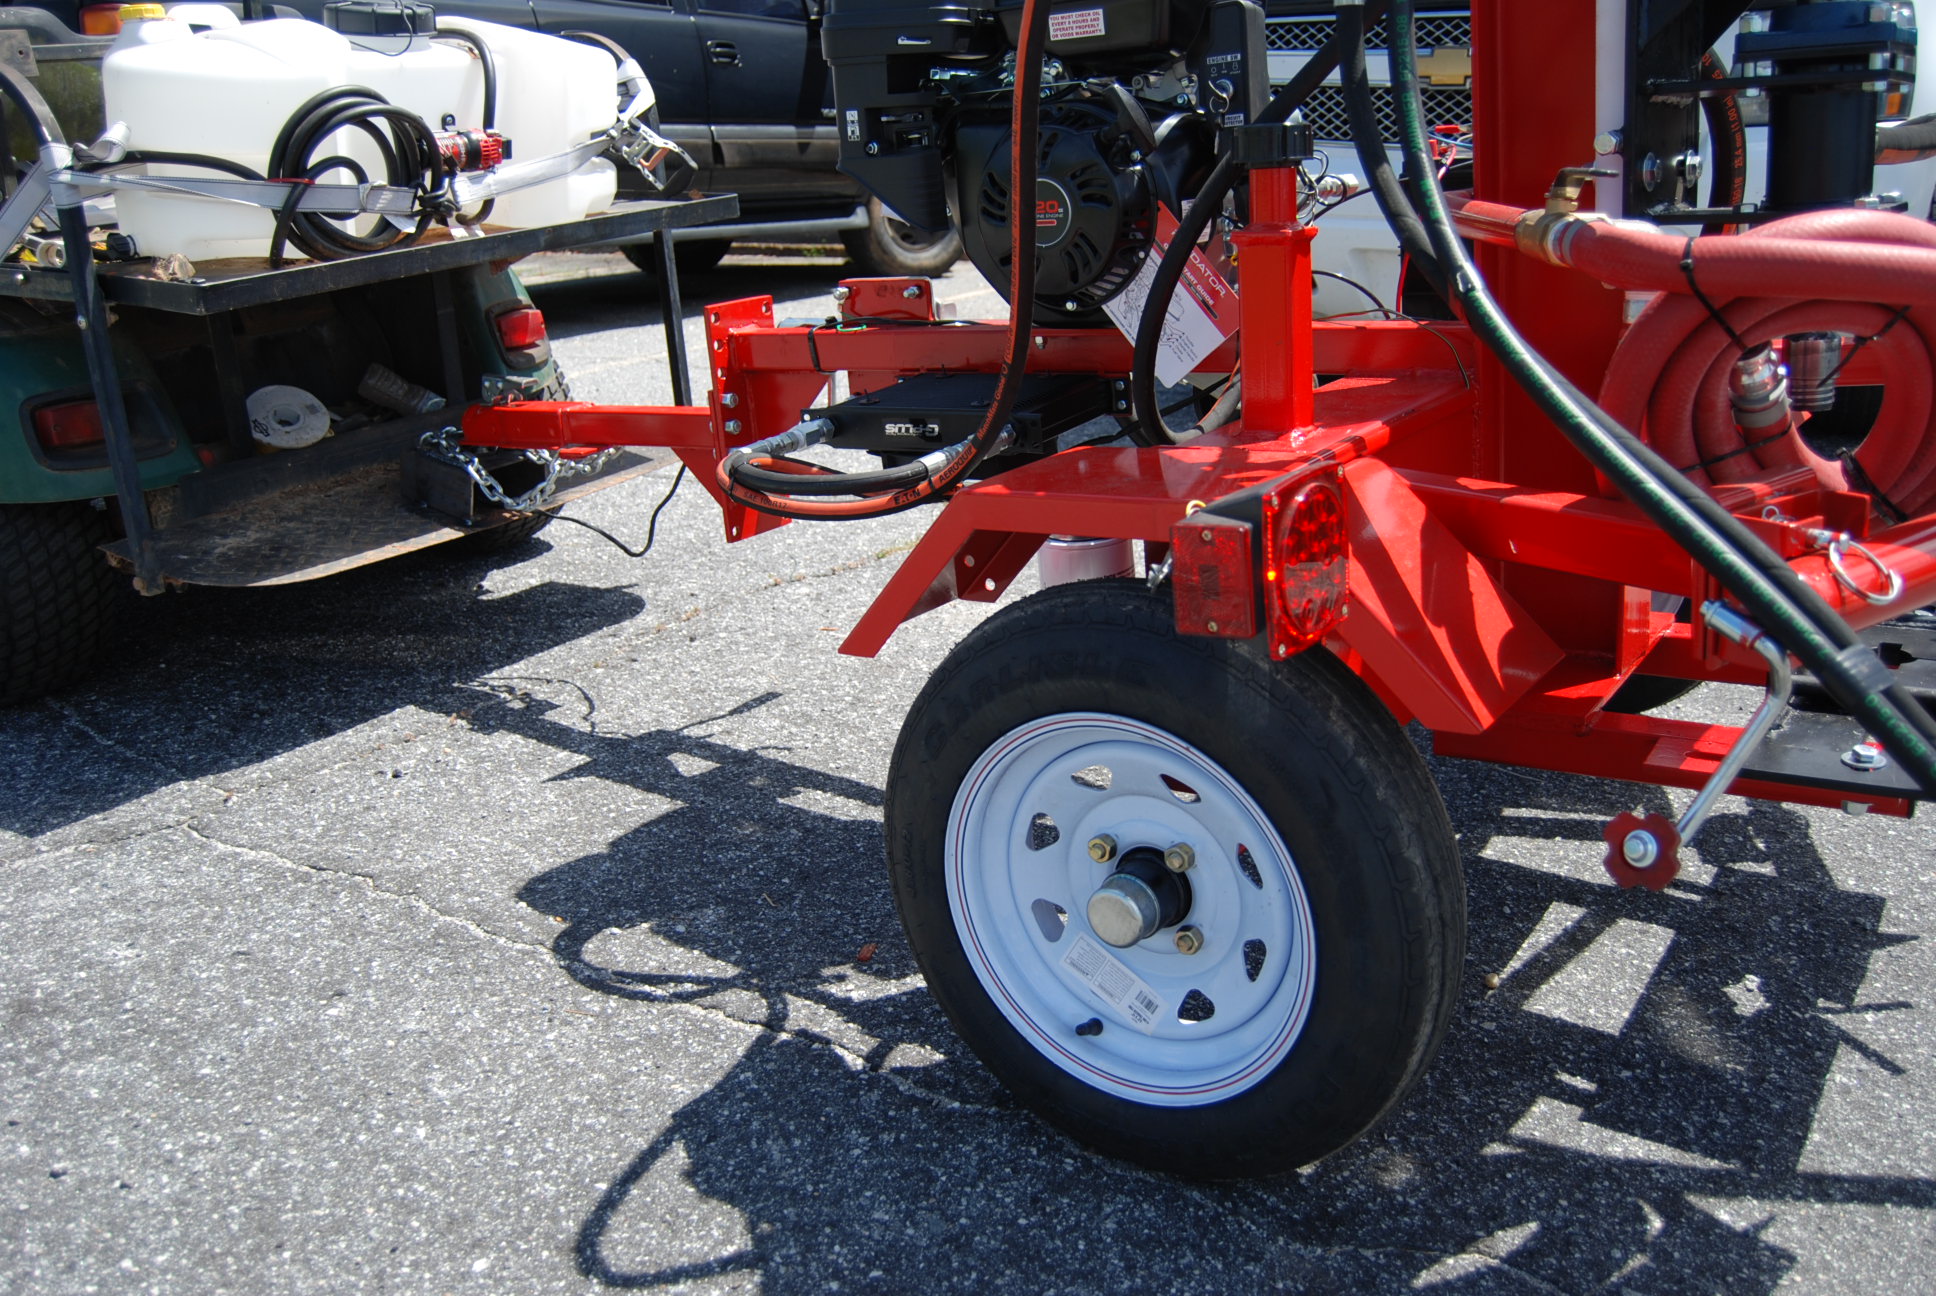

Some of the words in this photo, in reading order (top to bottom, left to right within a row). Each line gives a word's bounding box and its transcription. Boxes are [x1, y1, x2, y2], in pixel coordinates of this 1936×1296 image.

[1402, 92, 1424, 152] WINNER
[1036, 200, 1059, 213] 20
[1190, 253, 1226, 296] DATOR
[1196, 285, 1214, 305] GUIDE
[938, 445, 976, 483] AEROQUIP
[924, 651, 1155, 760] CARLISLE
[1865, 693, 1927, 757] EC215-0
